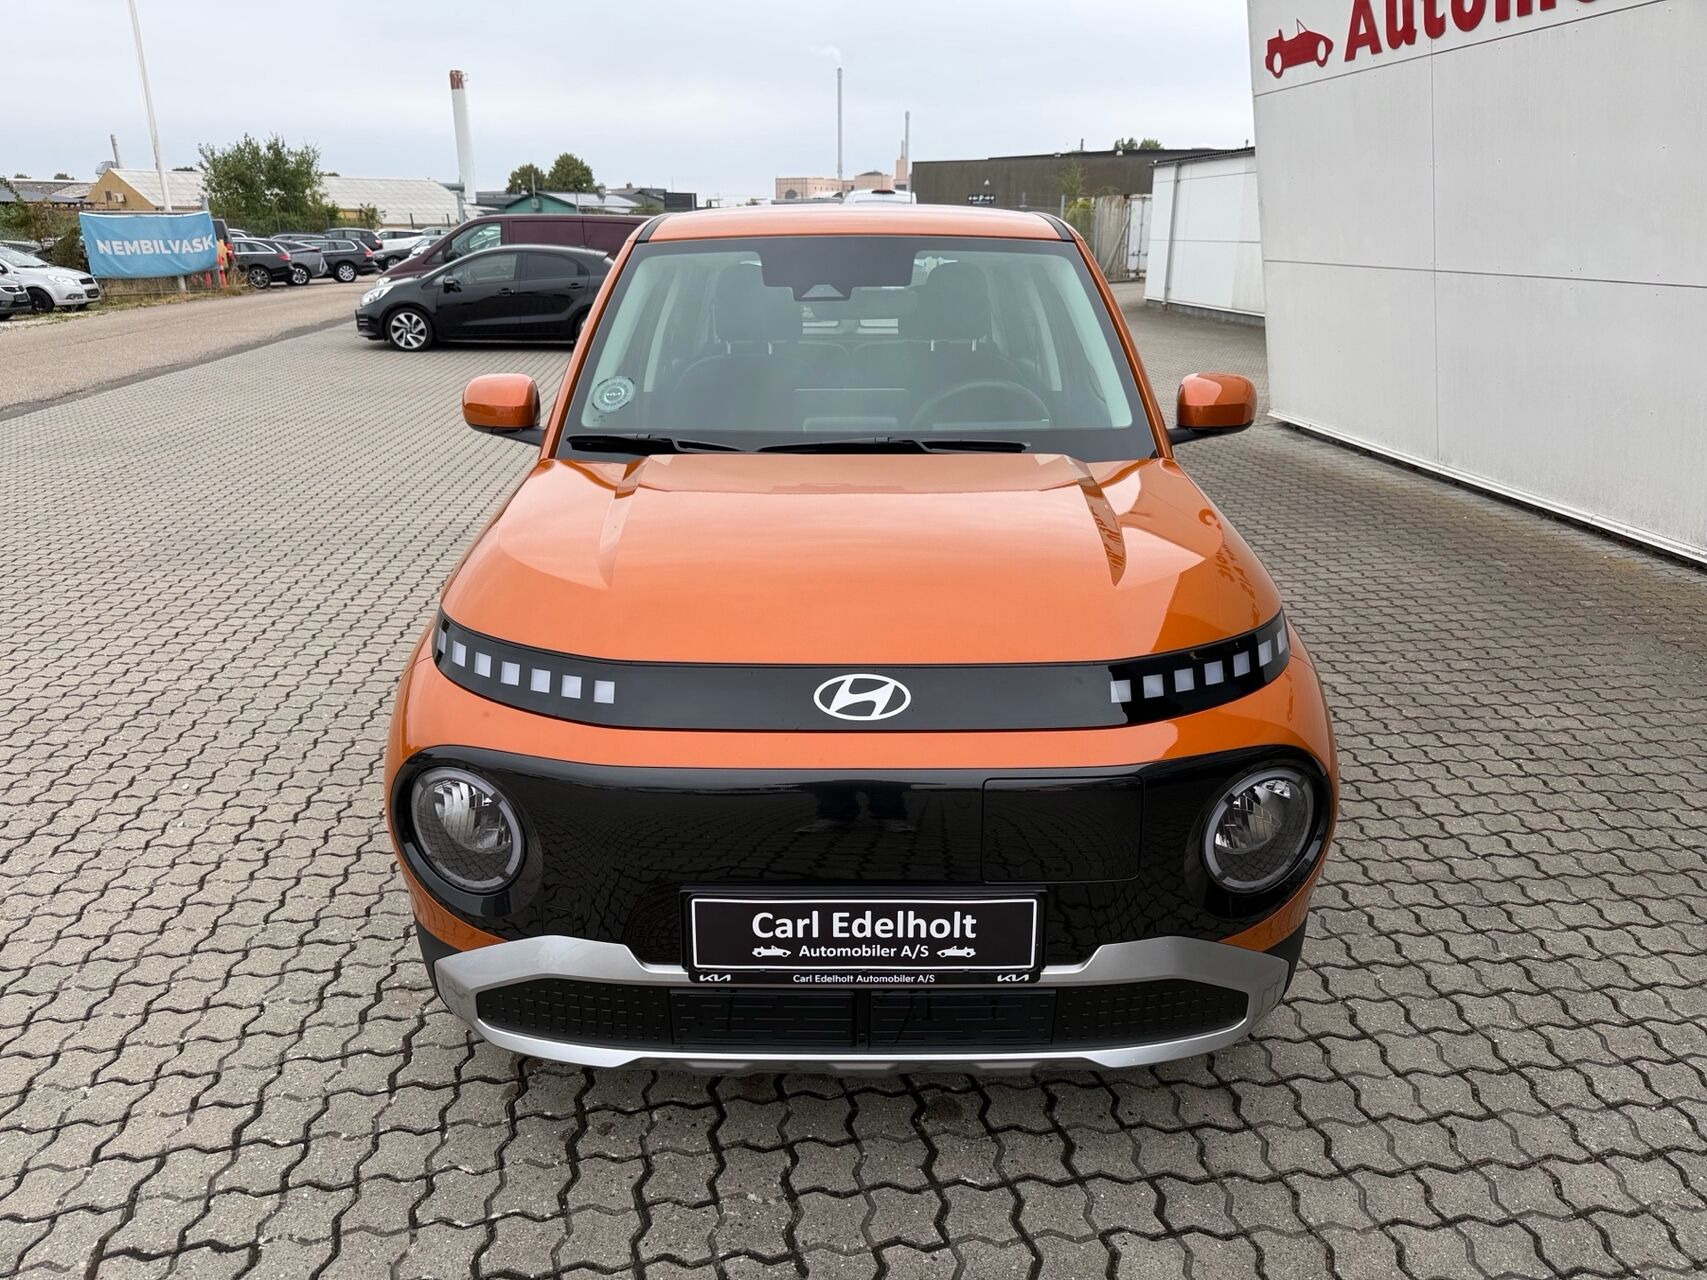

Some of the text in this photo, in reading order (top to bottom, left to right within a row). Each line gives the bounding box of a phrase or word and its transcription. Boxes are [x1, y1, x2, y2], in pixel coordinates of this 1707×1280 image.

[95, 234, 215, 256] NEMBILVASK
[751, 910, 977, 938] Carl Edelholt
[798, 944, 929, 959] Automobiler A/S
[792, 974, 936, 984] Carl Edelholt Automobiler A/S
